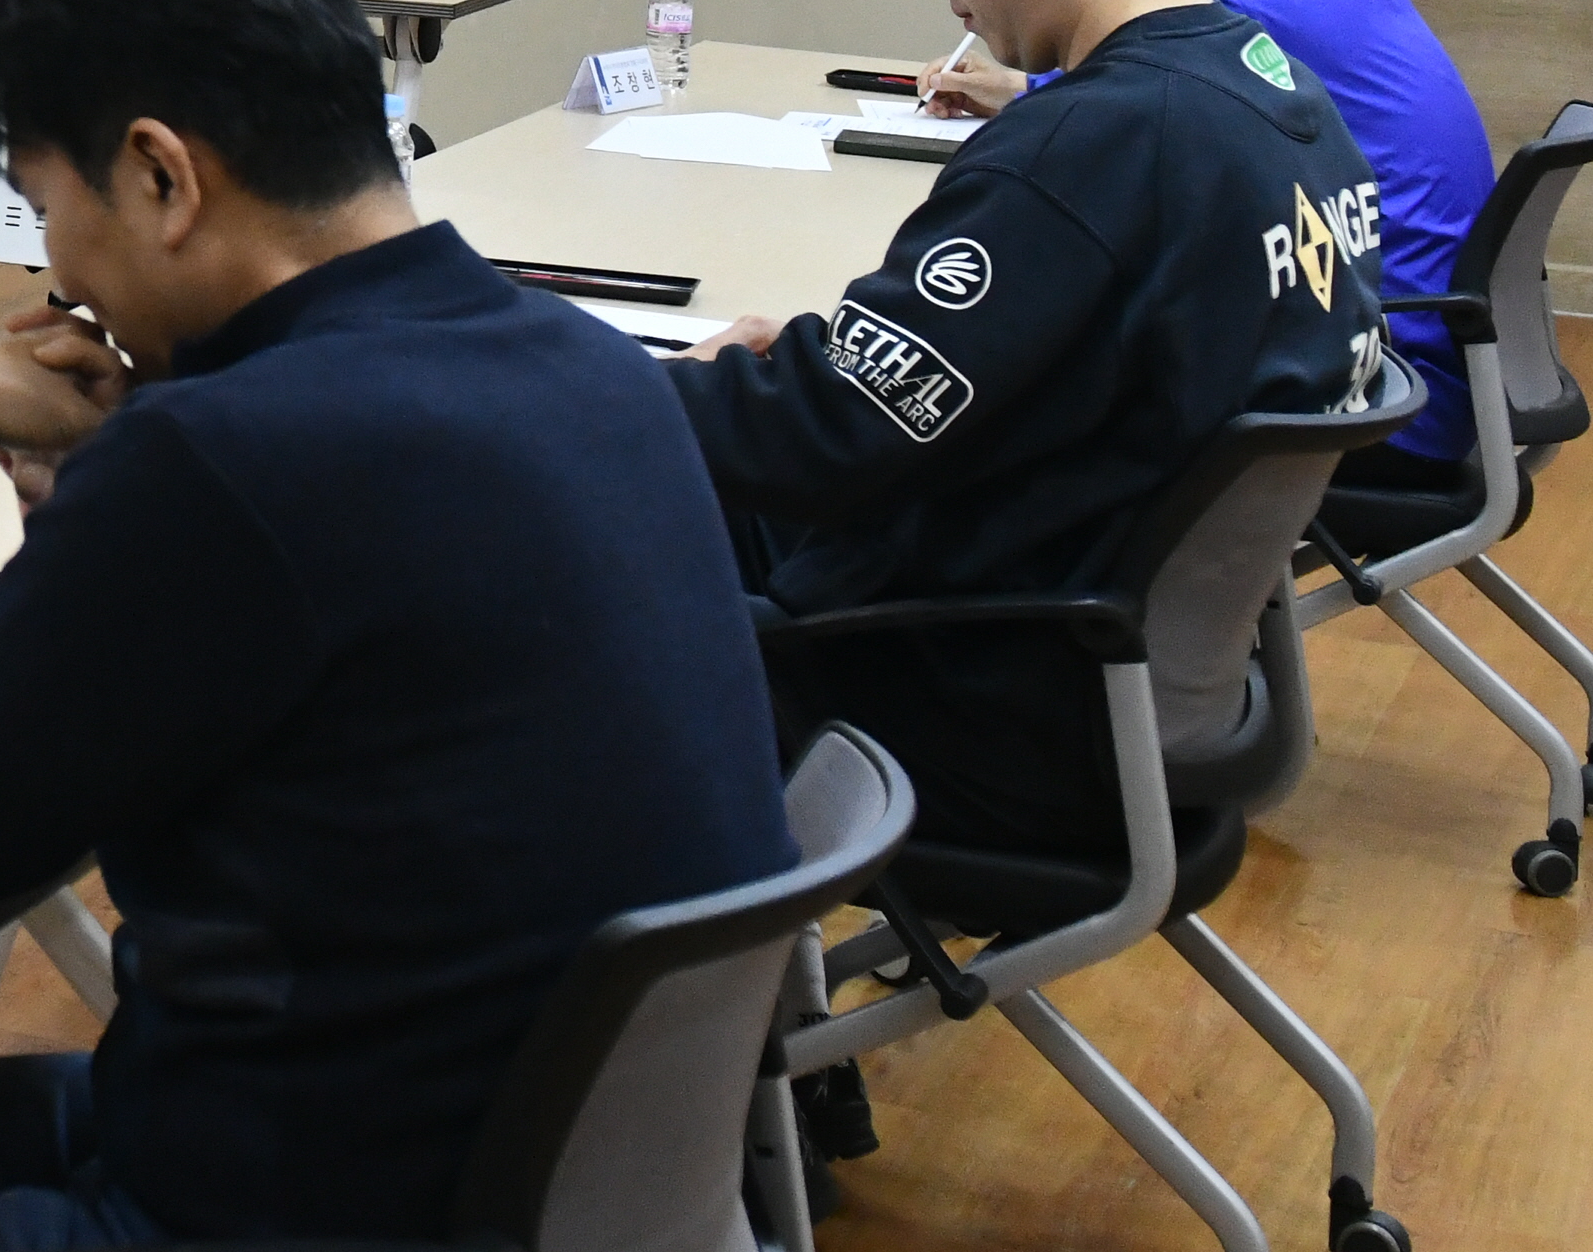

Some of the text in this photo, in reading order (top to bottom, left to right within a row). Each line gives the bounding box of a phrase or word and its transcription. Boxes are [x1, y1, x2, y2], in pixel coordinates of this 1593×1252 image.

[824, 342, 936, 432] FROM THE ARC
[830, 309, 952, 419] LETHAL
